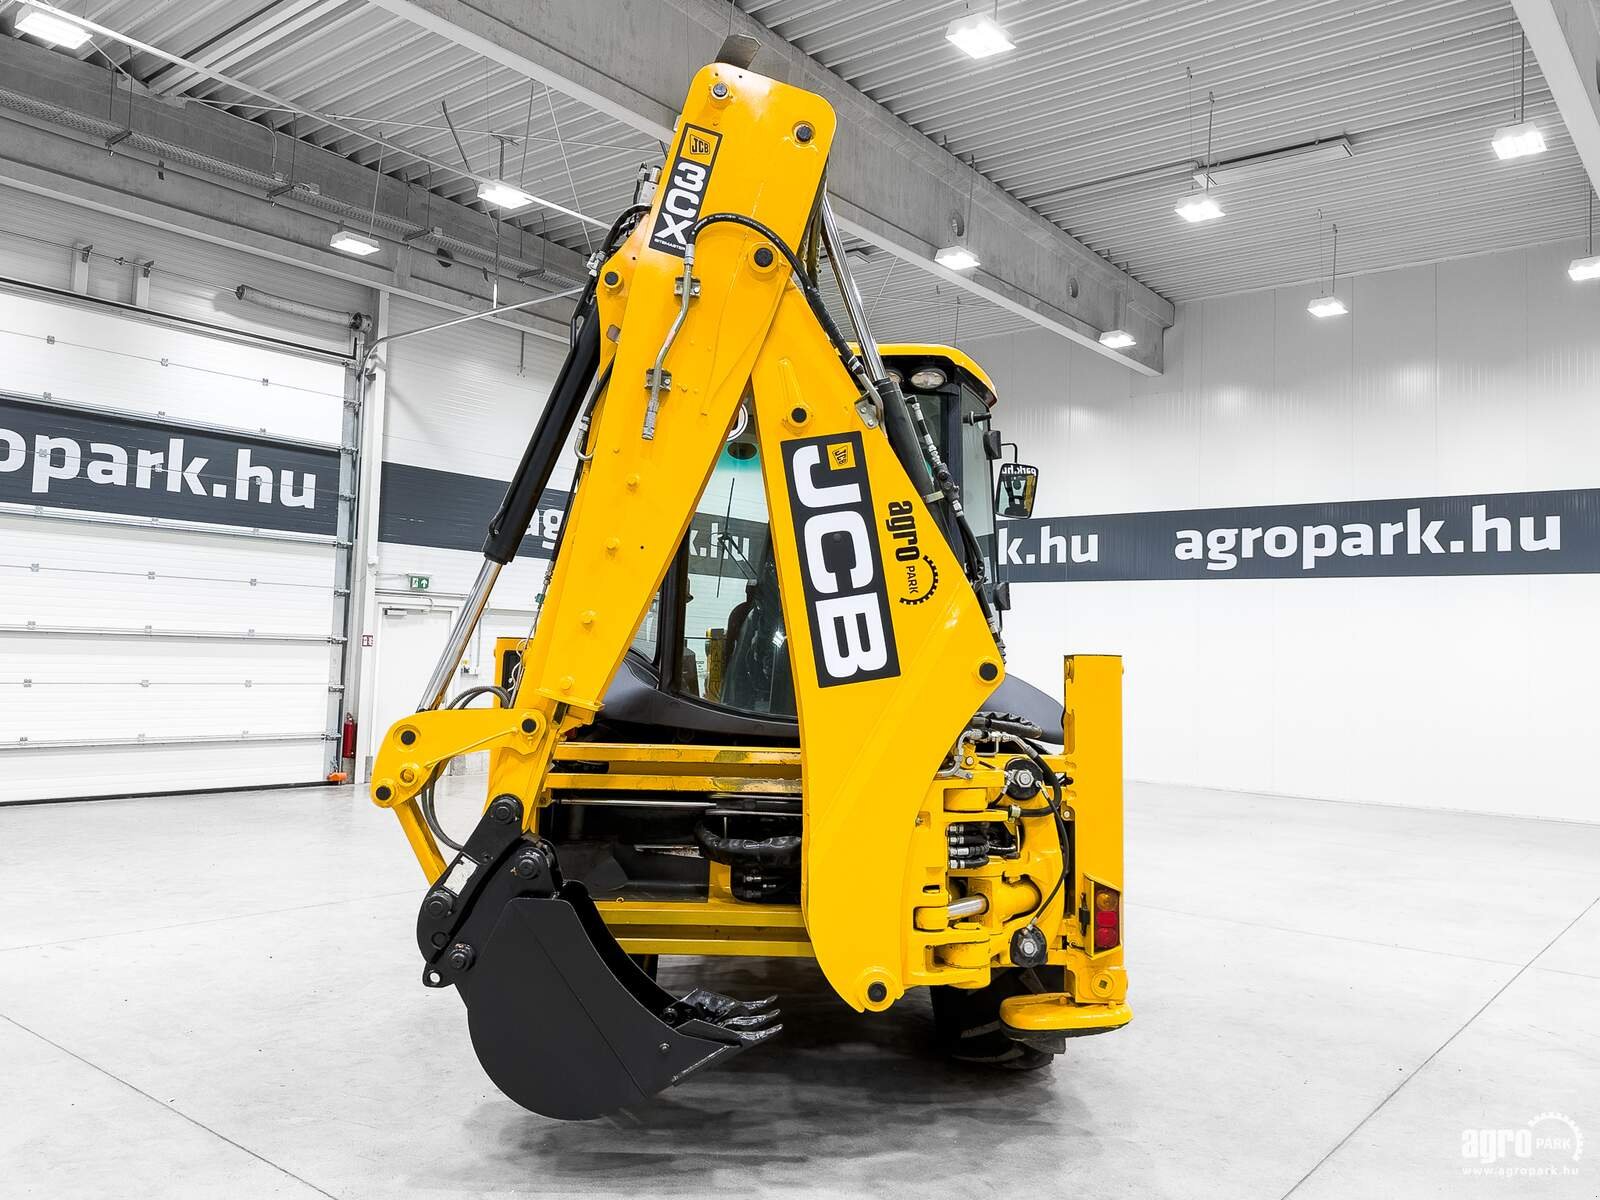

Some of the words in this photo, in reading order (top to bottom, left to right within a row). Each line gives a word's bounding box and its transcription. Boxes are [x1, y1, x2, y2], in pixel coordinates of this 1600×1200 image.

[691, 137, 710, 153] JCB
[654, 162, 706, 245] 3CX
[834, 448, 847, 465] JCB
[793, 445, 887, 678] JCB
[886, 500, 919, 562] agro
[905, 565, 918, 594] PARK
[998, 525, 1098, 565] k.hu
[1175, 504, 1561, 571] agropark.hu
